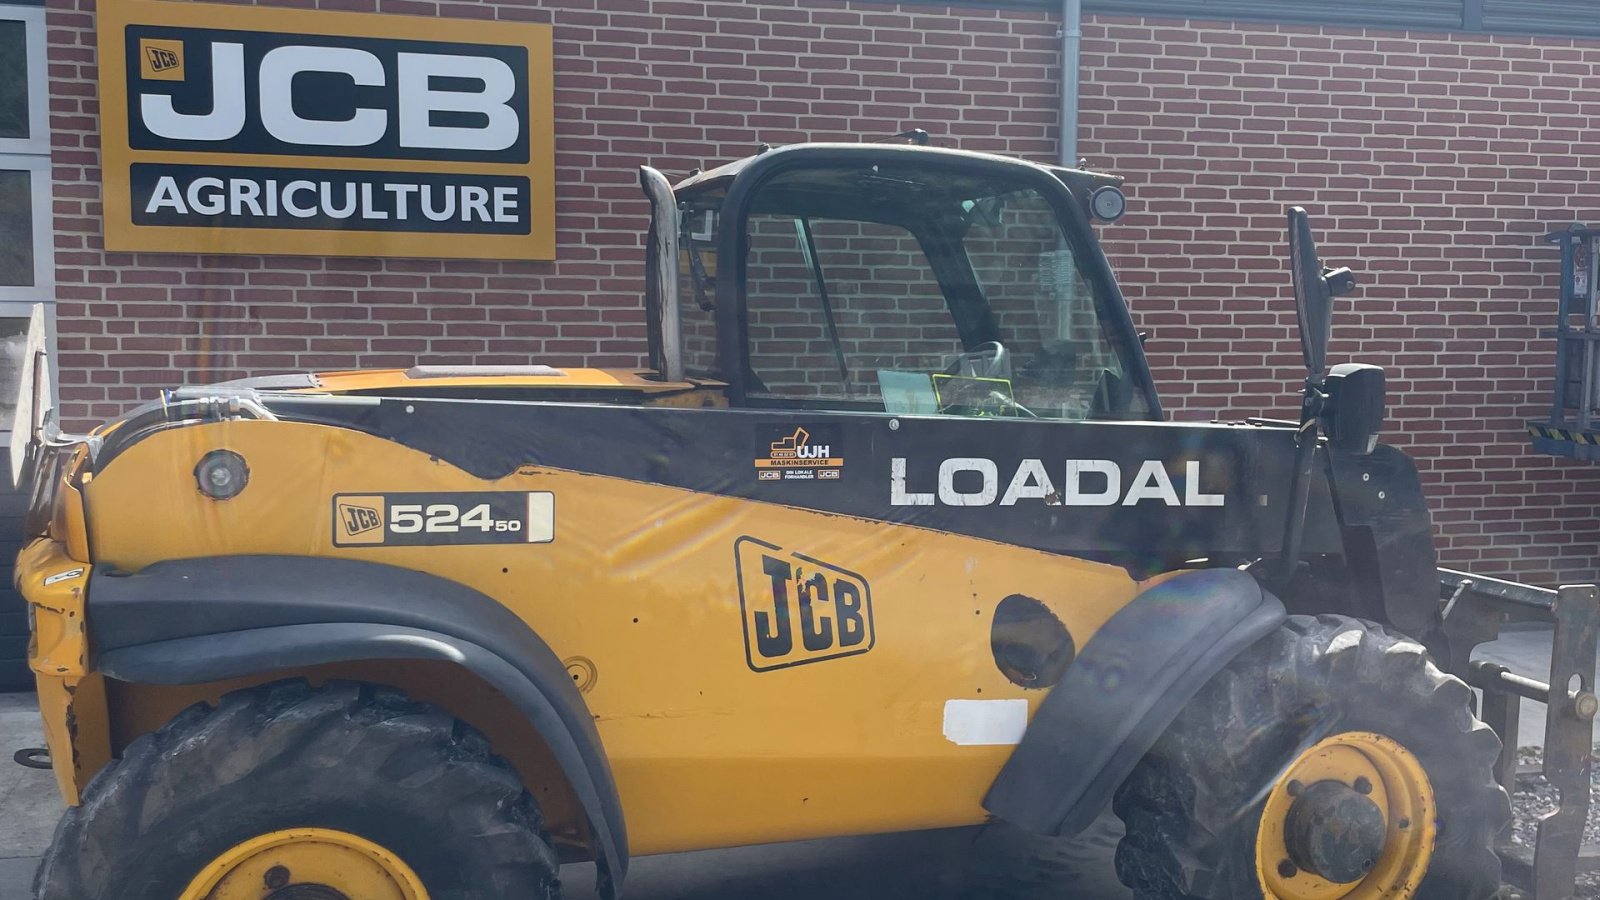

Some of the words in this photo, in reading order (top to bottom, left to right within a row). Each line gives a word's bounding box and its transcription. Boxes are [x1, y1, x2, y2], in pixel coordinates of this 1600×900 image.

[150, 49, 178, 69] JCB
[140, 41, 520, 151] JCB
[145, 175, 519, 223] AGRICULTURE
[797, 445, 830, 458] UJH
[890, 457, 1225, 506] LOADAL
[346, 507, 380, 533] JCB
[389, 503, 494, 533] 524
[494, 520, 521, 532] 50
[754, 554, 865, 658] JCB
